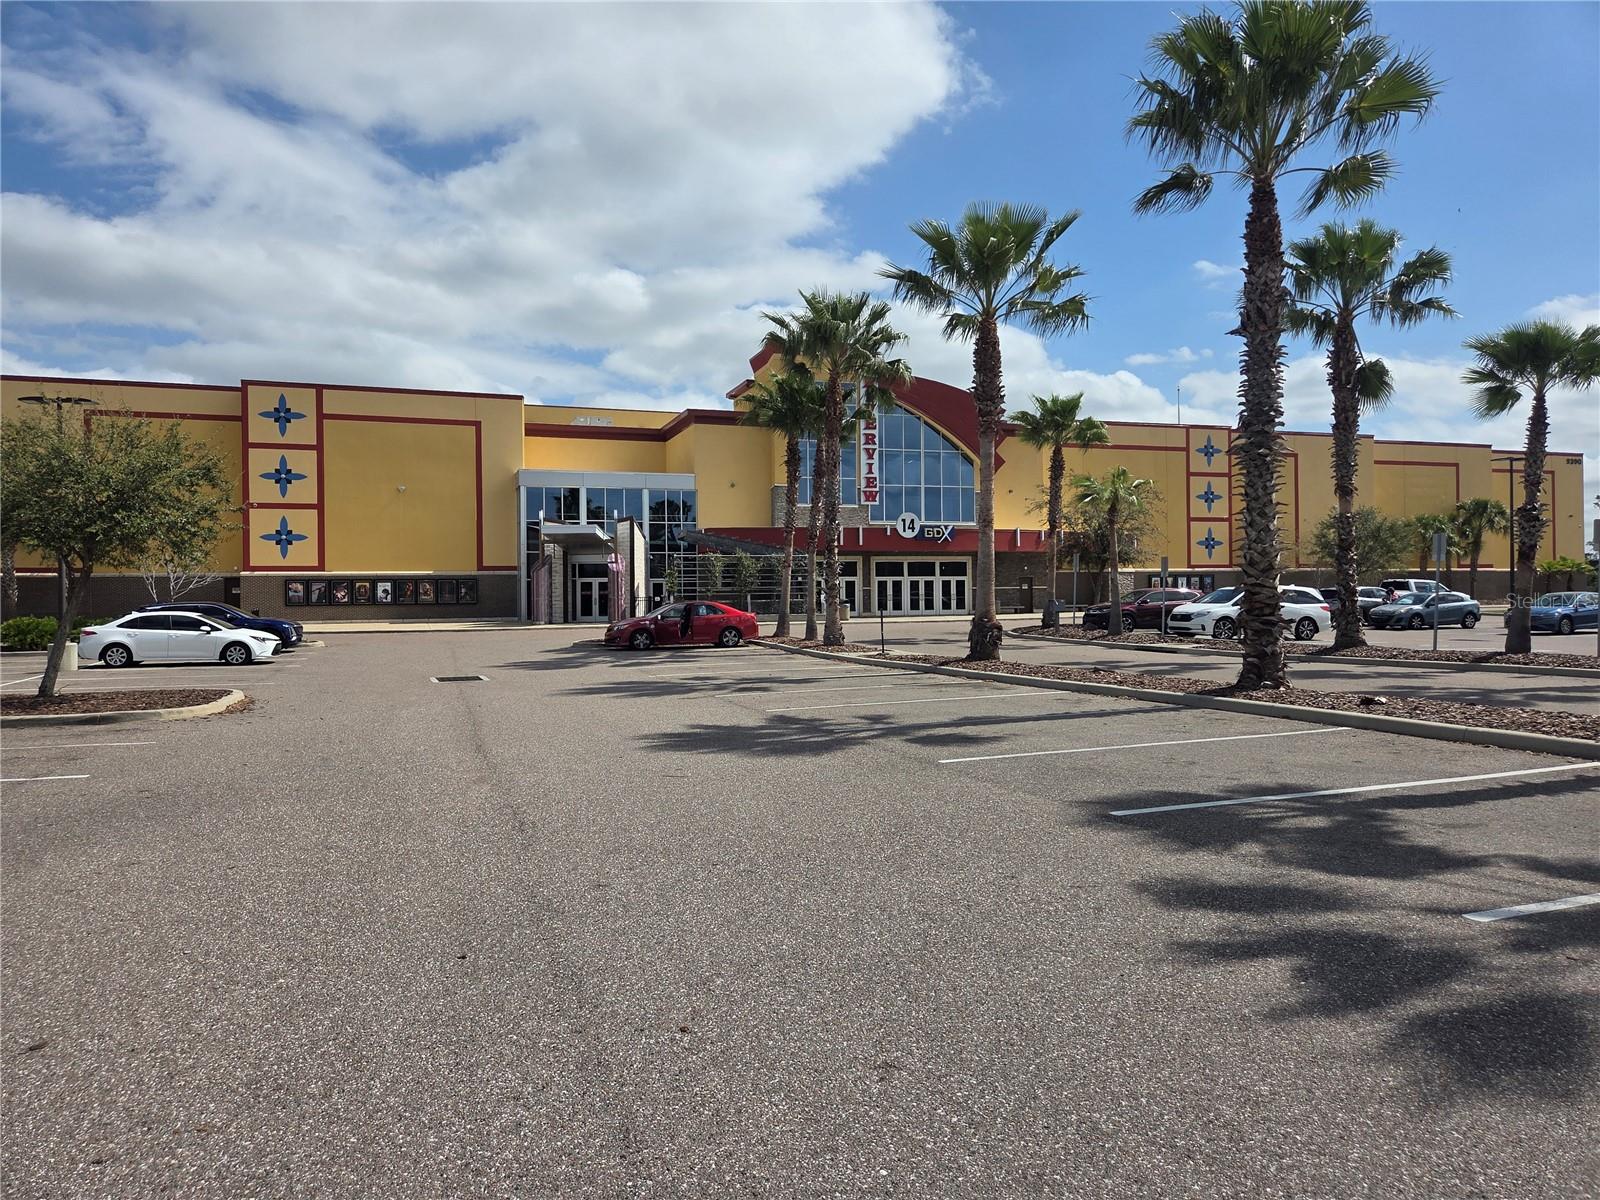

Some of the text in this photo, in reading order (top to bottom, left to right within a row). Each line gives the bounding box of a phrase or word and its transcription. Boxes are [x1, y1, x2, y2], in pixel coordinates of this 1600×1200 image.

[862, 380, 880, 503] ERVIEW
[901, 518, 916, 533] 14
[924, 525, 954, 544] GDX
